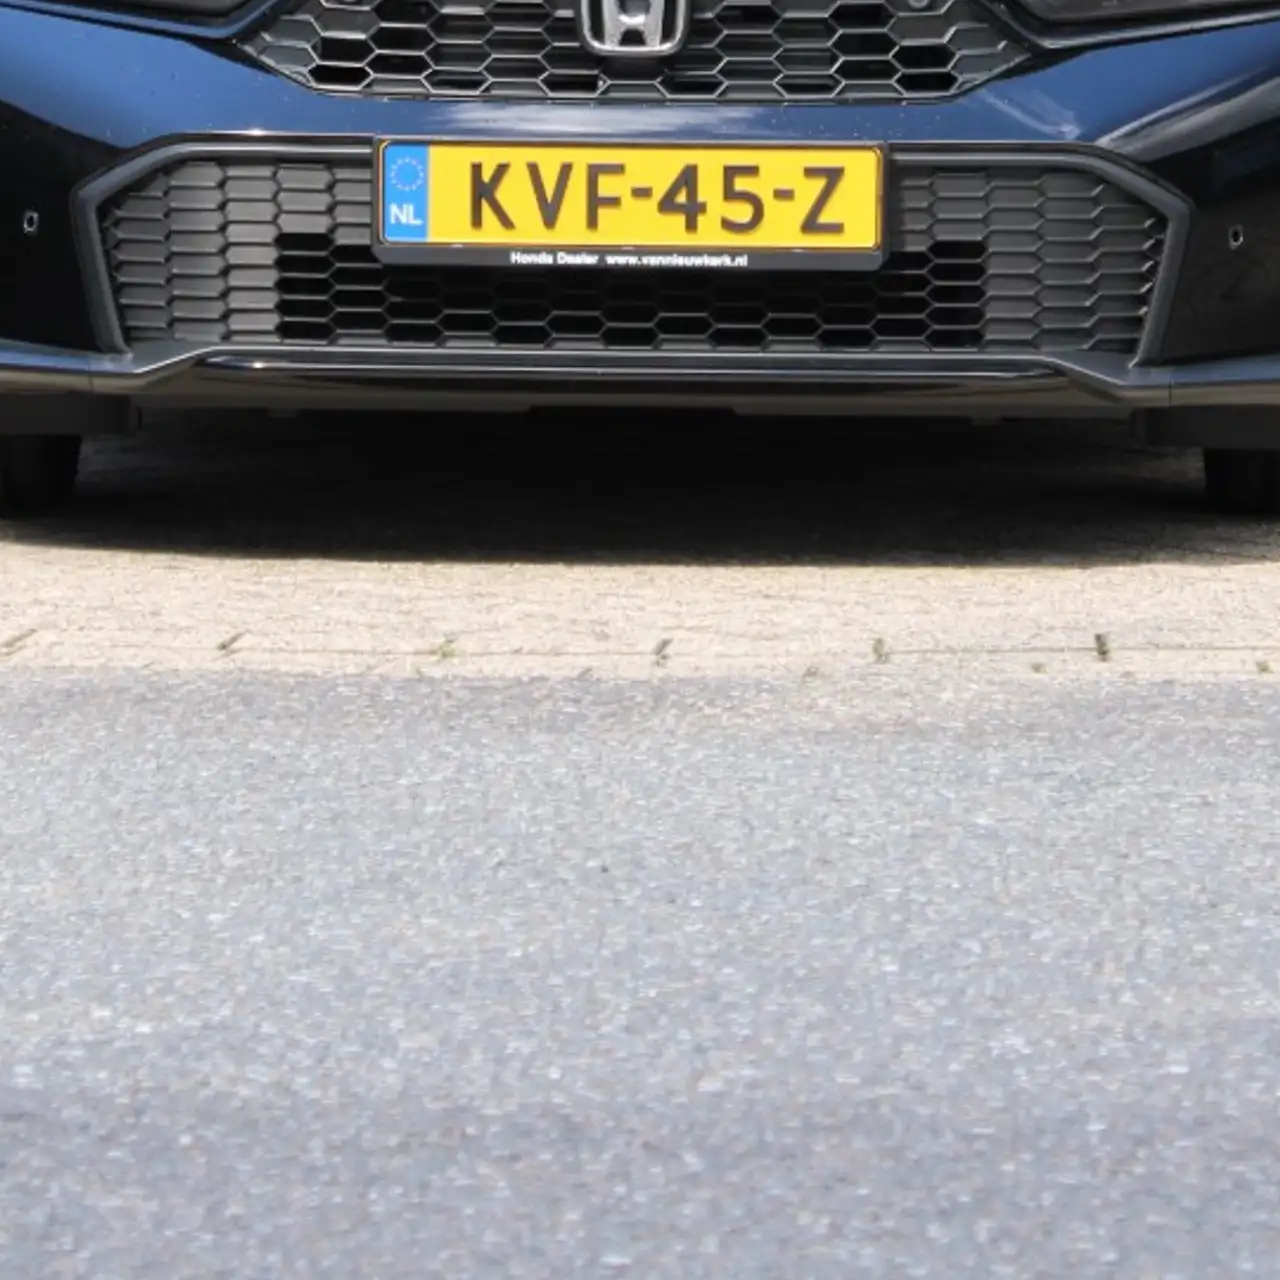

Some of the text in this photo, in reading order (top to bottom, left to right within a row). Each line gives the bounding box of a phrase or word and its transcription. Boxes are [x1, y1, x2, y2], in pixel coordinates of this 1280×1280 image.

[470, 161, 846, 235] KVF-45-Z
[390, 203, 424, 226] NL
[510, 251, 553, 265] Honda
[557, 251, 599, 265] Dealer
